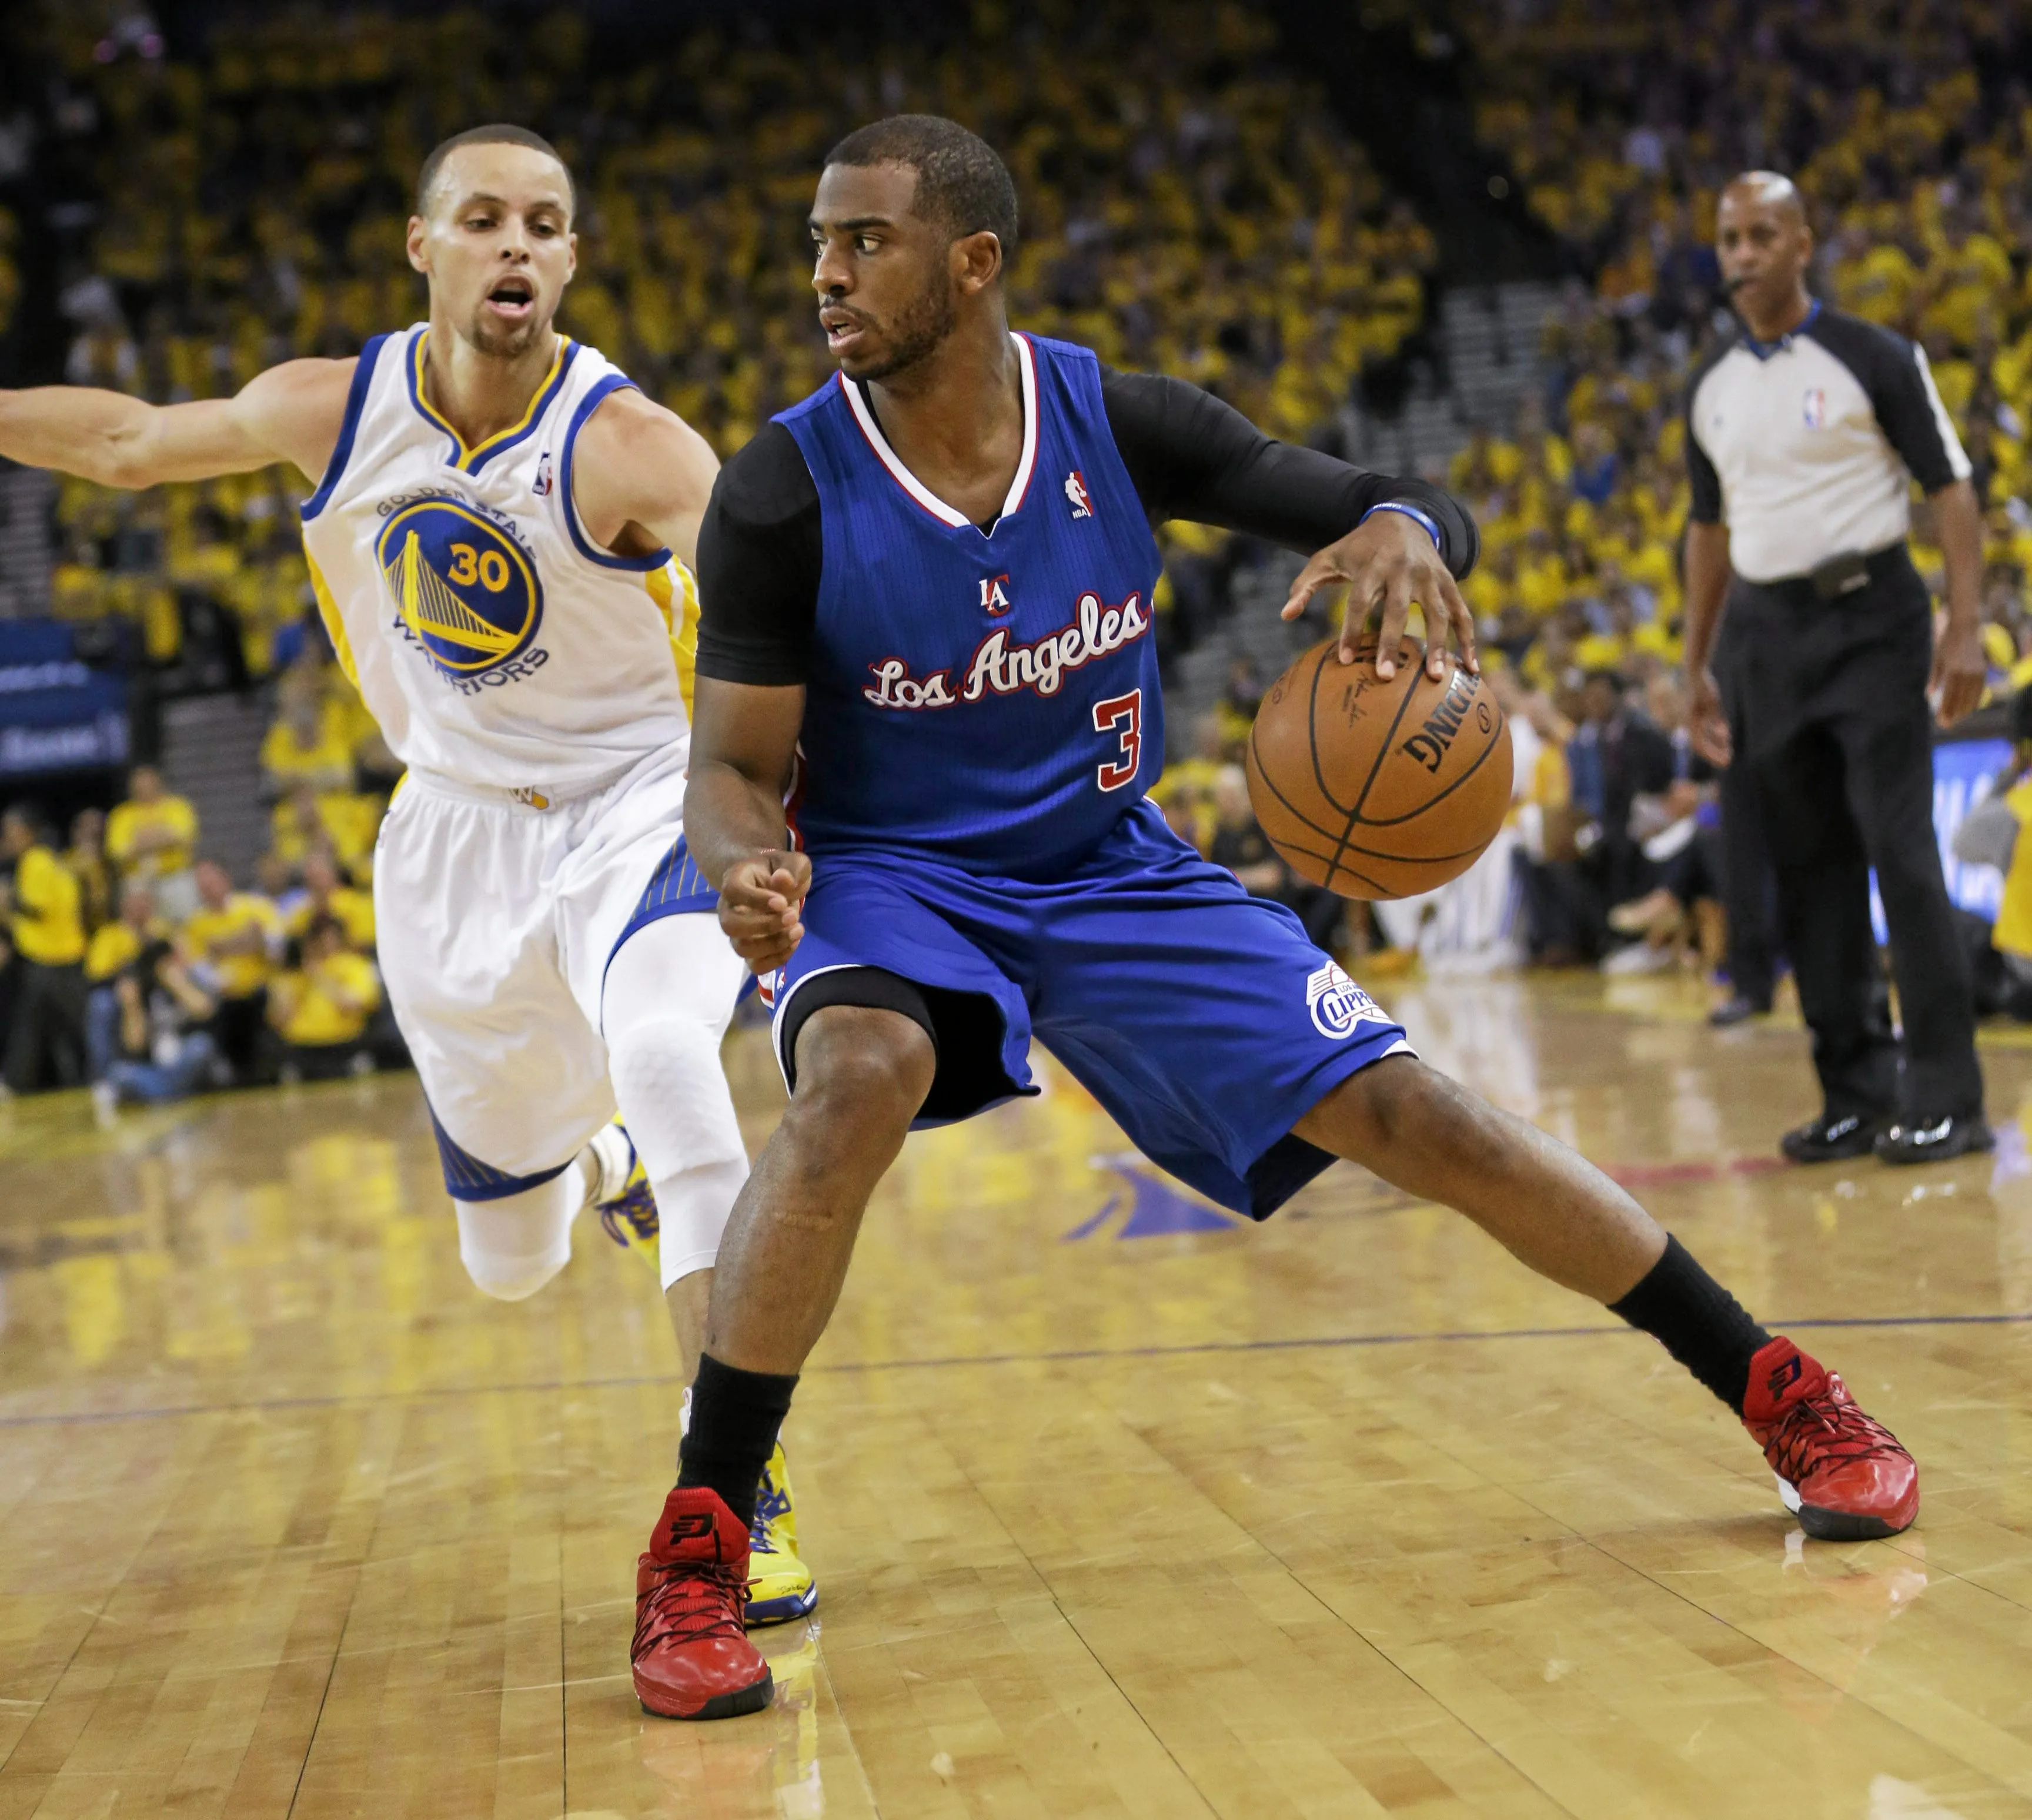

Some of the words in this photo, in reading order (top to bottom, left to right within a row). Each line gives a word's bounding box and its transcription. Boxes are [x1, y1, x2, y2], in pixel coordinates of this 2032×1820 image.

[1072, 508, 1087, 519] NBA
[447, 543, 510, 593] 30
[863, 657, 960, 710] Los
[962, 590, 1150, 701] Angeles
[1092, 687, 1142, 792] 3
